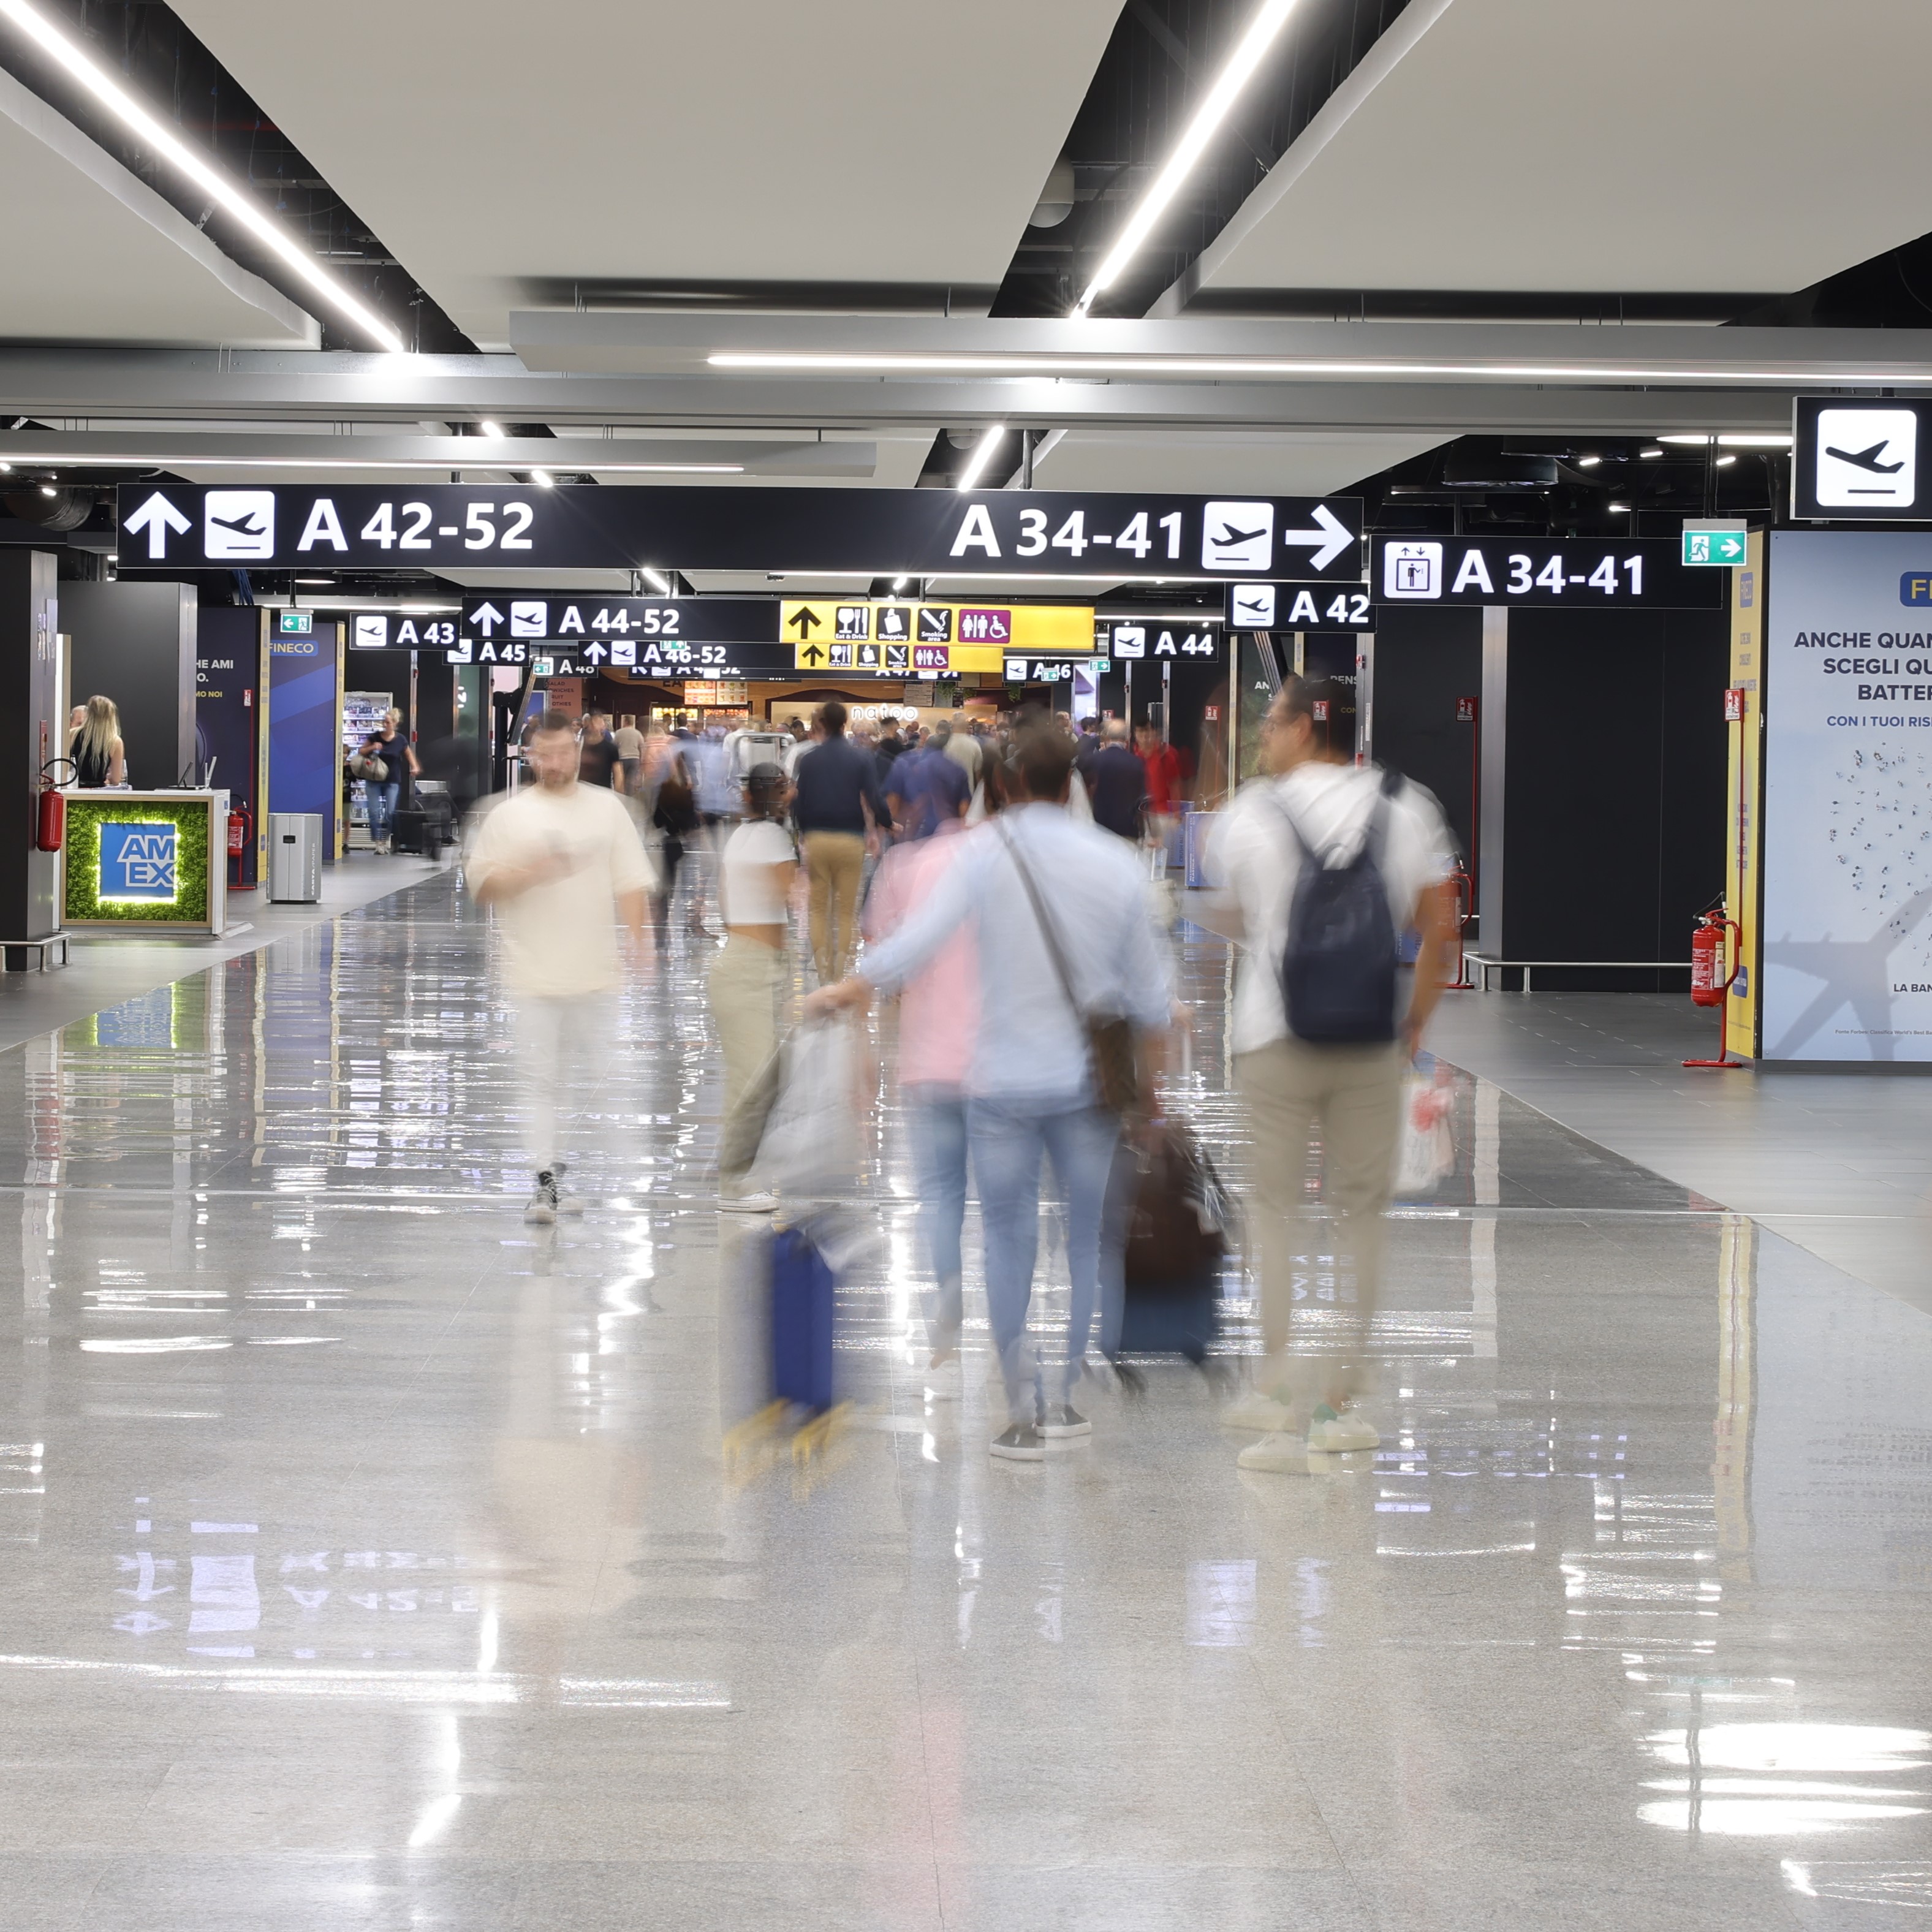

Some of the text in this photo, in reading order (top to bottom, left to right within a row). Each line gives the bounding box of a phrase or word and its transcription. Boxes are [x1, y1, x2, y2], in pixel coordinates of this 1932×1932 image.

[297, 499, 533, 550] A 42-52
[950, 504, 1181, 558] A 34-41
[1452, 550, 1642, 594] A 34-41
[1289, 591, 1369, 623] A 42
[559, 606, 679, 634] A 44-52
[396, 620, 455, 644] A 43
[1794, 632, 1871, 648] ANCHE
[479, 642, 525, 662] A 45
[1154, 631, 1214, 655] A 44
[643, 644, 726, 663] A 46-52
[211, 659, 233, 669] AMI
[559, 659, 573, 674] A
[1823, 657, 1899, 674] SCEGLI
[851, 704, 919, 721] natoo
[1827, 716, 1932, 727] CON I TUOI RIS
[1894, 983, 1907, 992] LA
